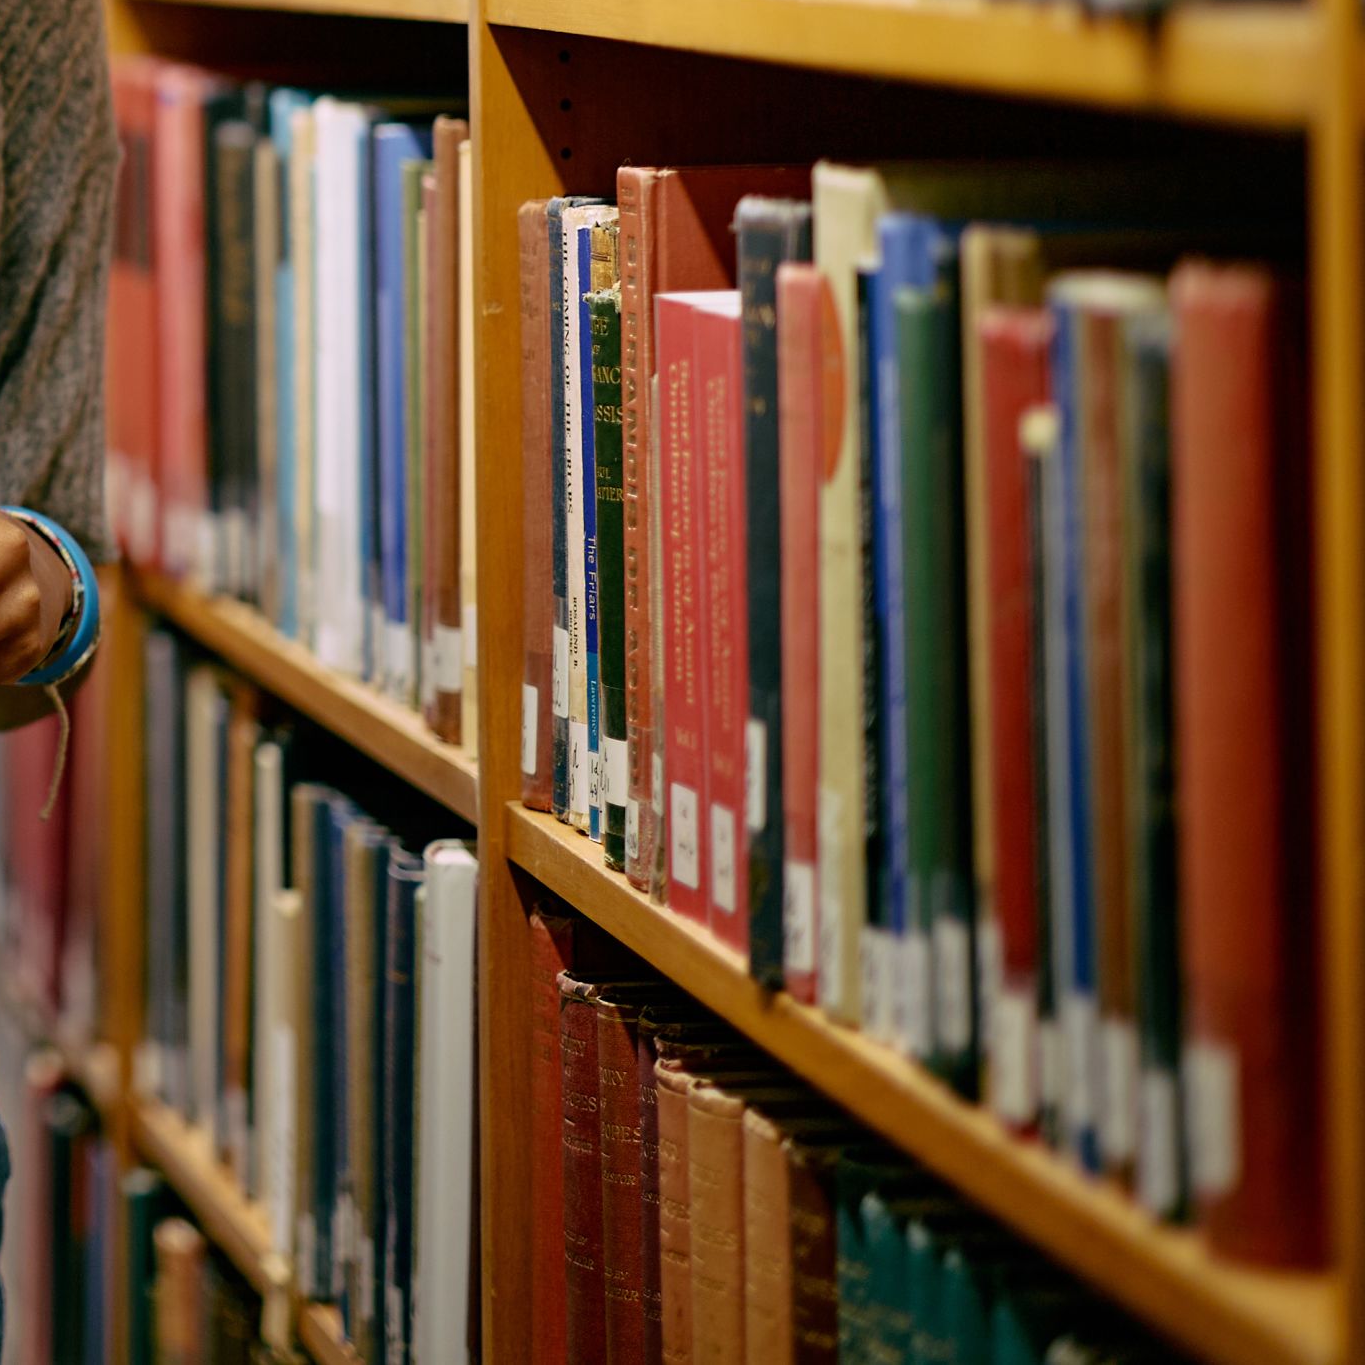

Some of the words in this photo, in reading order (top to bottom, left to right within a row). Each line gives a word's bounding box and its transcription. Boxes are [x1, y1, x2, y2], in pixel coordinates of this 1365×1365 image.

[626, 312, 638, 532] FRANCIS
[586, 535, 597, 564] The
[588, 570, 597, 621] Friars
[590, 680, 598, 736] Lawrence
